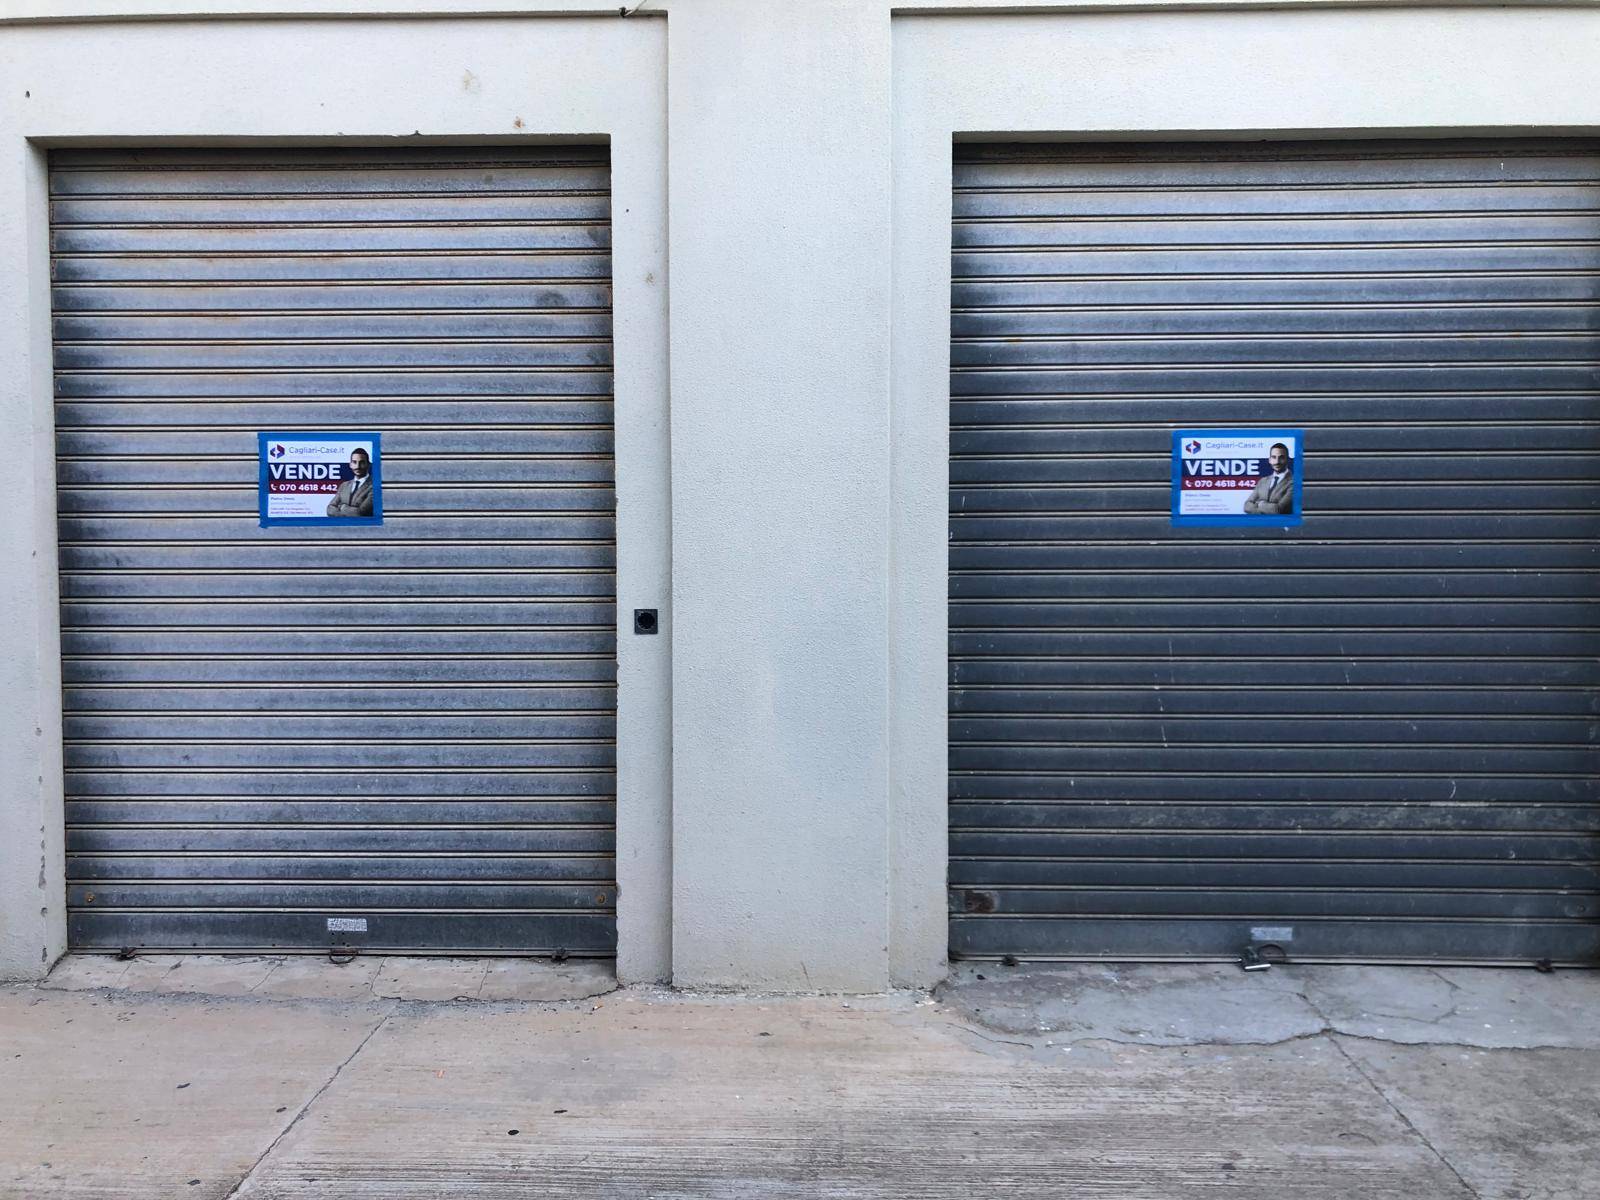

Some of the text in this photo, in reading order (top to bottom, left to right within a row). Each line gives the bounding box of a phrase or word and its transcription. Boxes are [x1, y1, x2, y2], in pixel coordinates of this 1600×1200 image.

[1205, 441, 1264, 450] Cagliari-Case.it
[288, 446, 345, 455] Cagliari-Case.it
[270, 464, 342, 480] VENDE
[1185, 459, 1260, 476] VENDE
[279, 483, 338, 491] 070 4618 442
[1194, 479, 1256, 488] 070 4618 442
